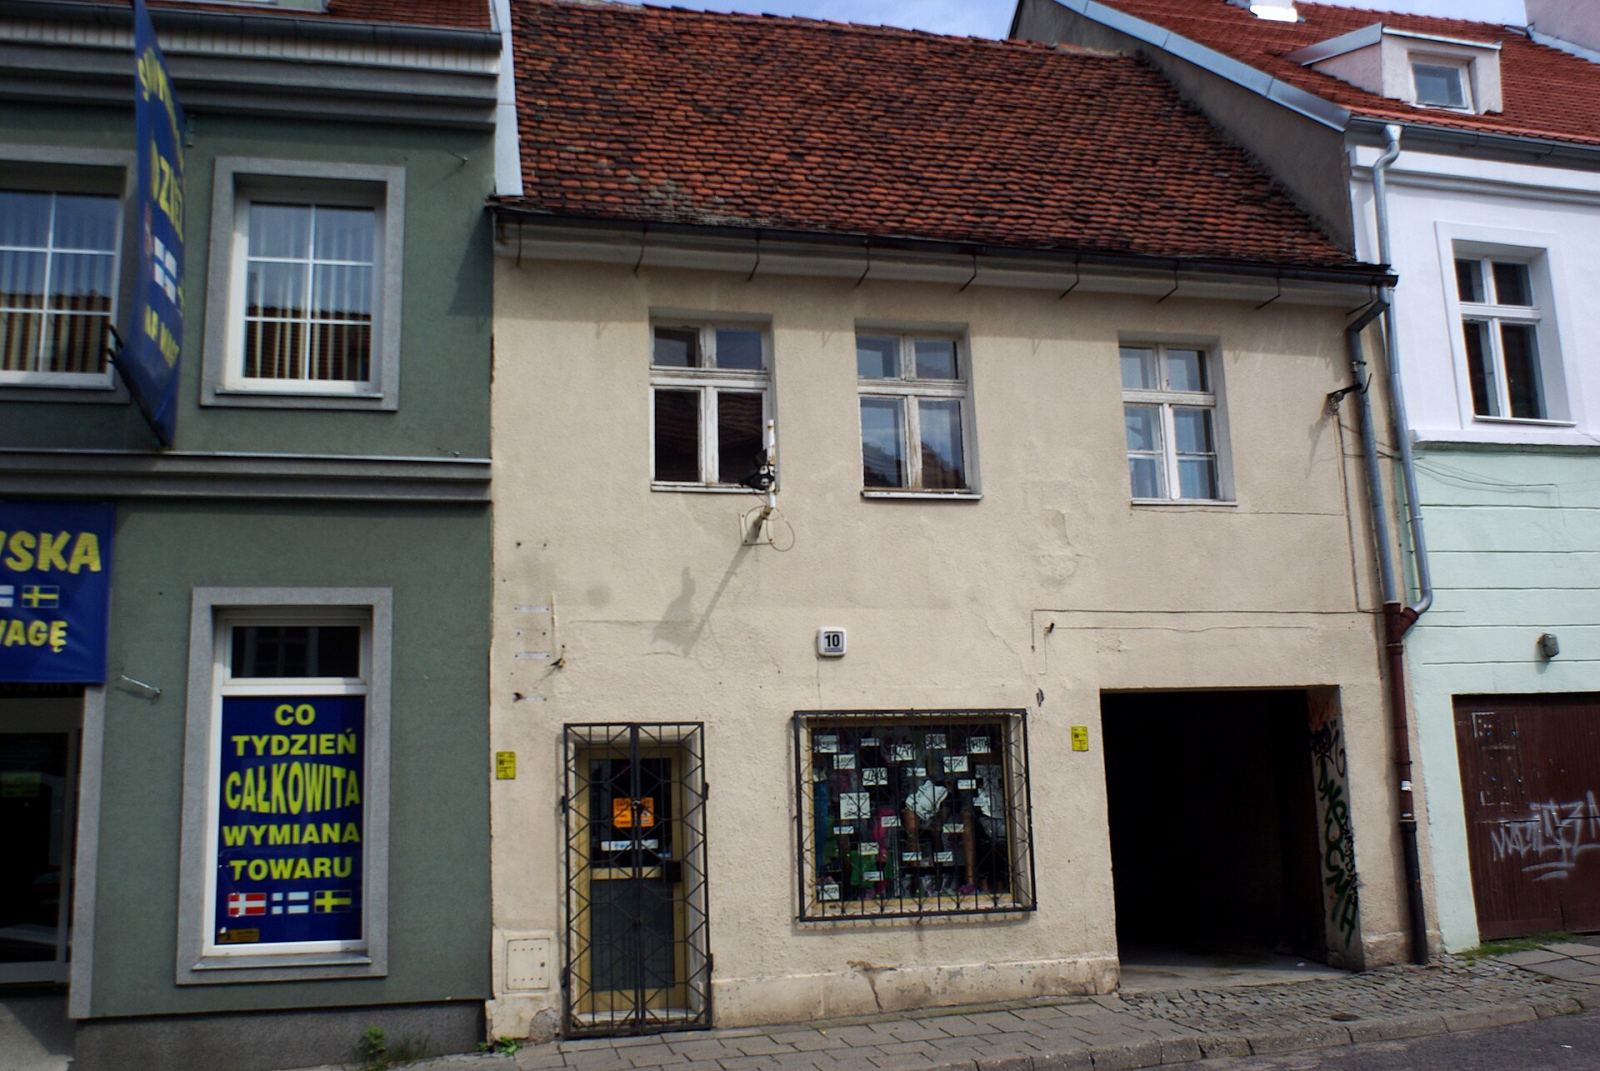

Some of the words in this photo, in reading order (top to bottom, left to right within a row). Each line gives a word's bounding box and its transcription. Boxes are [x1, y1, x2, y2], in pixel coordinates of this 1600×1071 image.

[0, 530, 101, 574] SKA
[0, 619, 68, 653] AGĘ
[824, 634, 840, 647] 10
[274, 703, 316, 726] CO
[231, 728, 357, 757] TYDZIEŃ
[225, 761, 360, 815] CAŁKOWITA
[222, 822, 360, 847] WYMIANA
[229, 856, 352, 881] TOWARU
